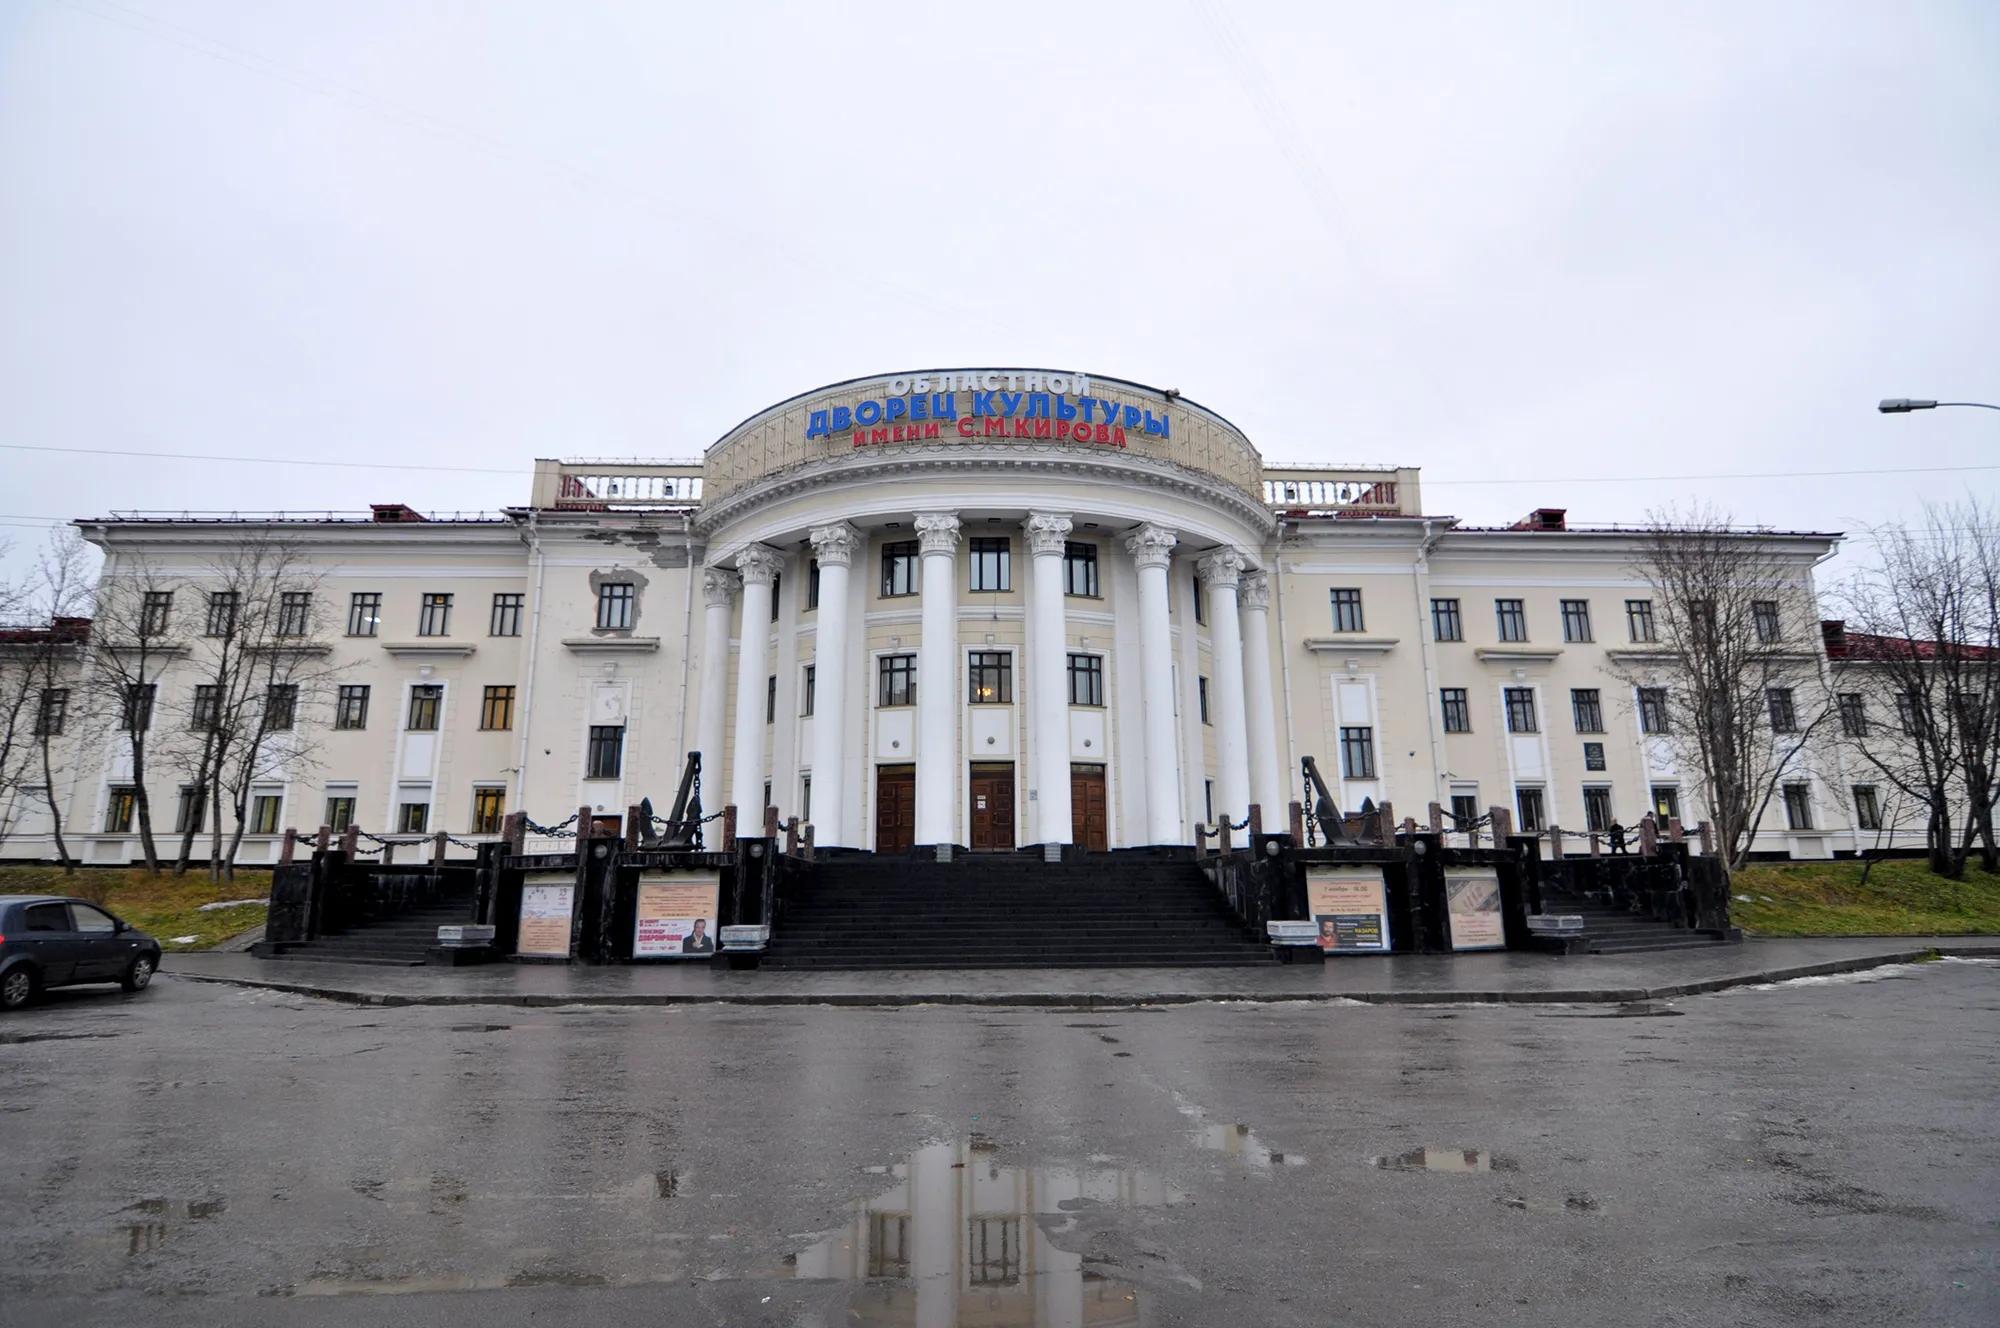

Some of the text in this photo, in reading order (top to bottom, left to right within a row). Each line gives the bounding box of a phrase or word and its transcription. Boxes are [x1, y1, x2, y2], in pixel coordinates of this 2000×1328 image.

[888, 372, 1091, 397] ОБЛАСТНОЙ
[806, 391, 1170, 440] ДВОРЕЦ КУЛЬТУРЫ
[852, 422, 940, 447] ИМЕНИ
